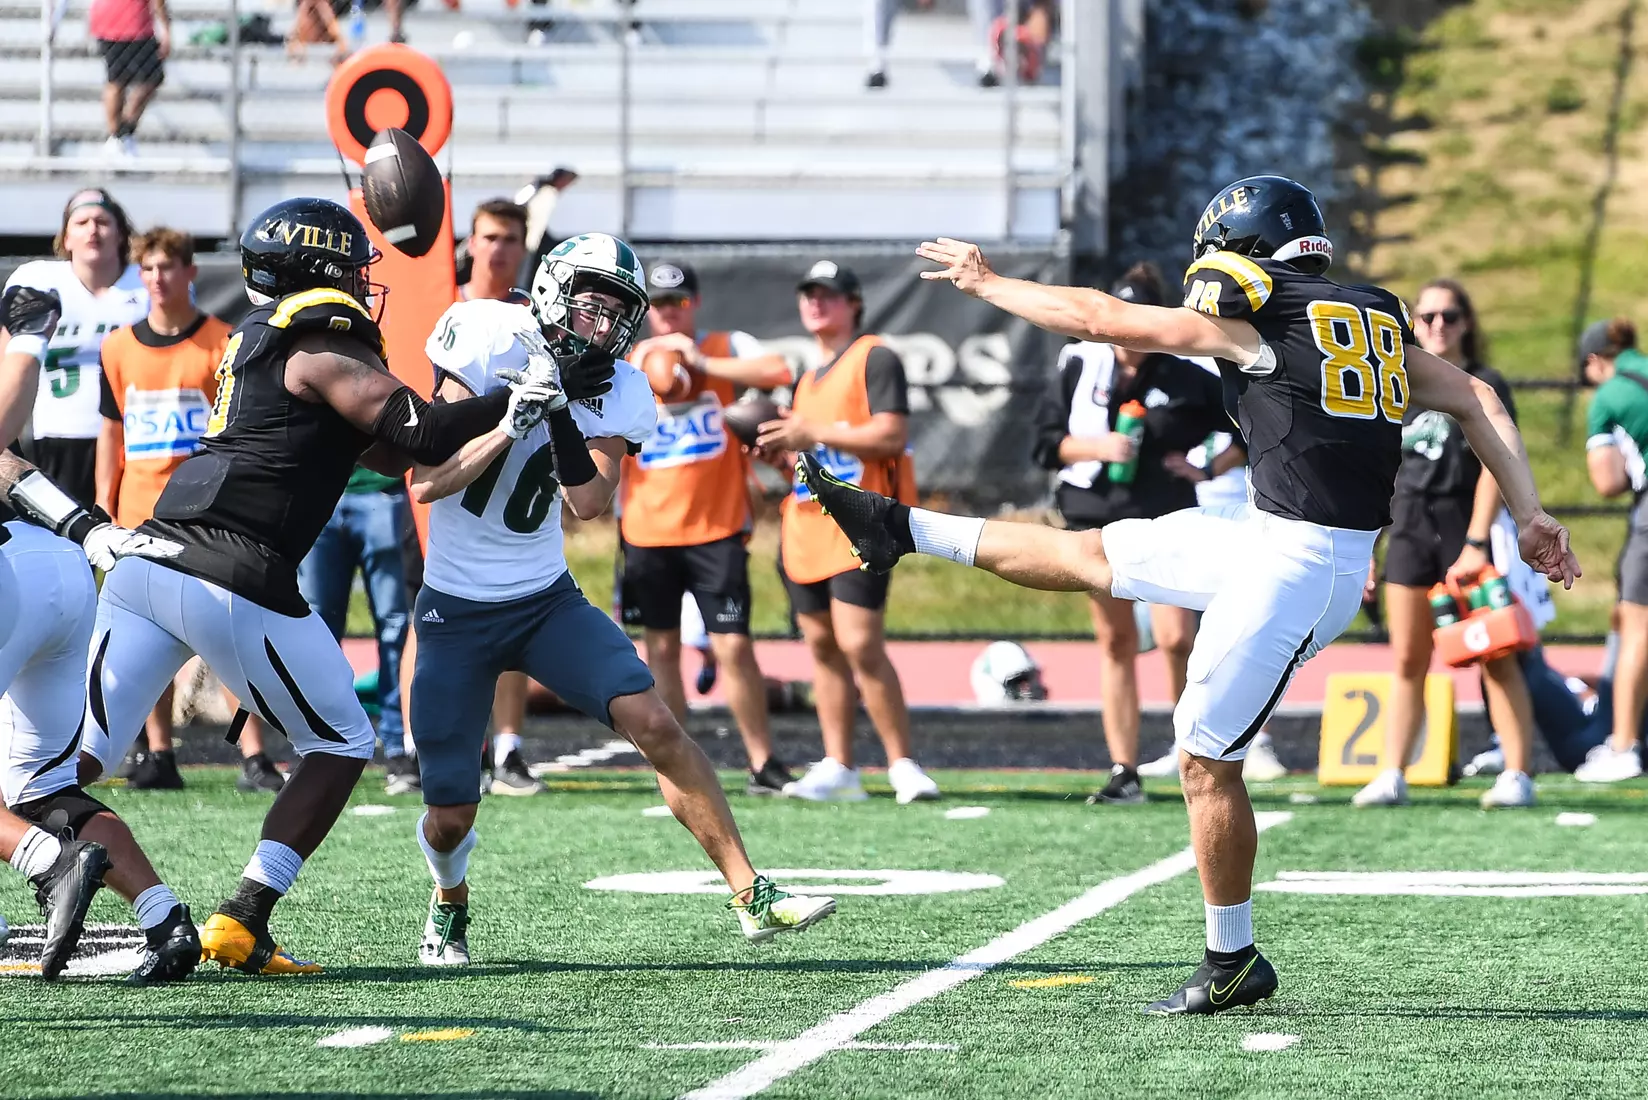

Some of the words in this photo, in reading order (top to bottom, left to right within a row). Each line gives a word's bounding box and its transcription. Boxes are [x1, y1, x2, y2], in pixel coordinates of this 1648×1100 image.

[283, 221, 352, 257] VILLE
[1193, 186, 1249, 244] VILLE
[44, 346, 81, 399] 5
[1306, 300, 1410, 424] 88
[655, 410, 717, 446] SAC
[460, 440, 562, 534] 16
[1341, 689, 1428, 766] 2
